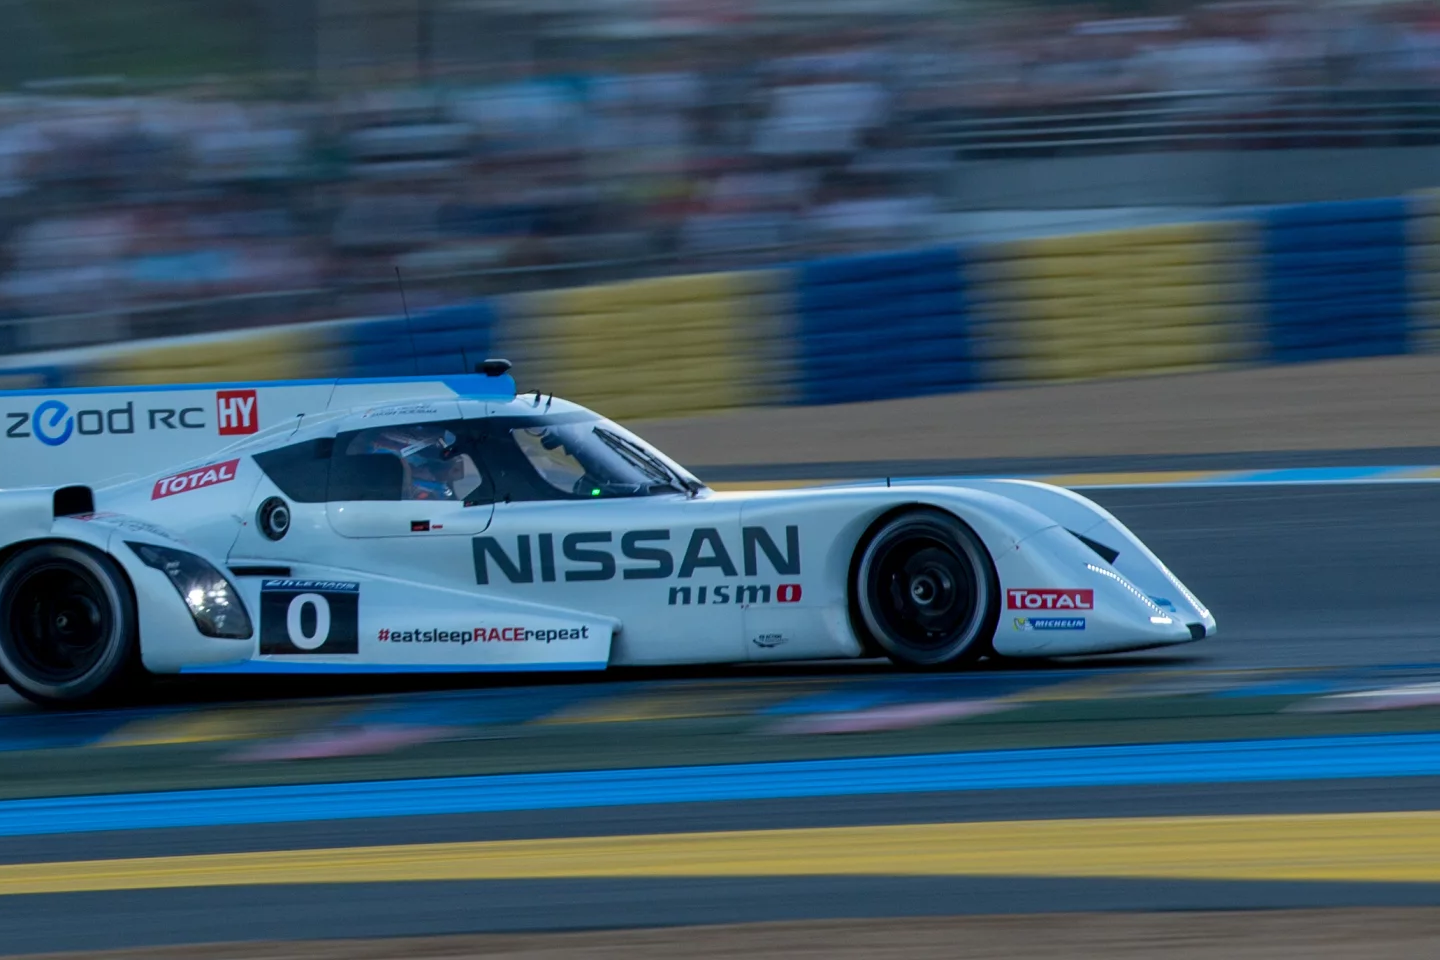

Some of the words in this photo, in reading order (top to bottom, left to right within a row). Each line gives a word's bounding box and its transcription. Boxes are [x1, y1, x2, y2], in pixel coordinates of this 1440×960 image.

[148, 407, 206, 430] RC
[217, 396, 256, 429] HY
[157, 465, 233, 495] TOTAL
[471, 525, 802, 585] NISSAN
[667, 583, 803, 606] nismo
[1009, 590, 1091, 609] TOTAL
[286, 593, 331, 650] 0
[1034, 619, 1085, 628] MICHELIN
[377, 625, 590, 645] #eatsleepRACErepeat
